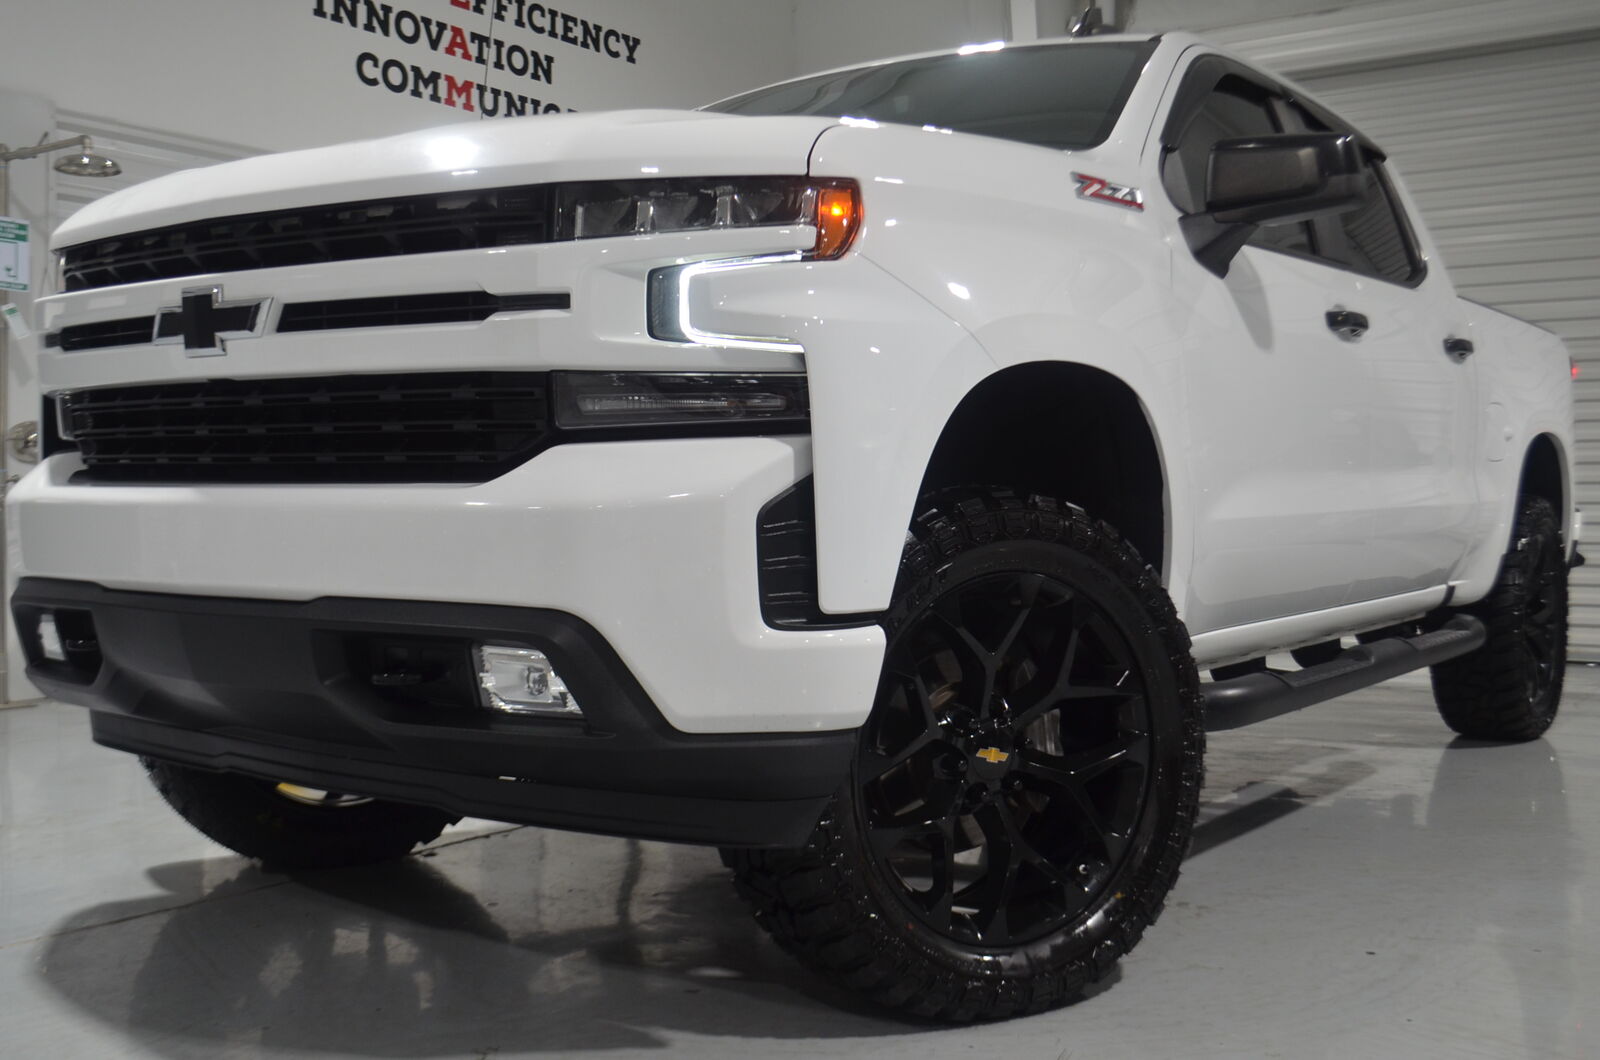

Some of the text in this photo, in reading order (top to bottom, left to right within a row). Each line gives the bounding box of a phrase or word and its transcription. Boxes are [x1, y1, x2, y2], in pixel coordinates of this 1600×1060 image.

[313, 0, 554, 84] INNOVATION
[356, 52, 578, 118] COMMUNI
[1070, 171, 1144, 212] Z71
